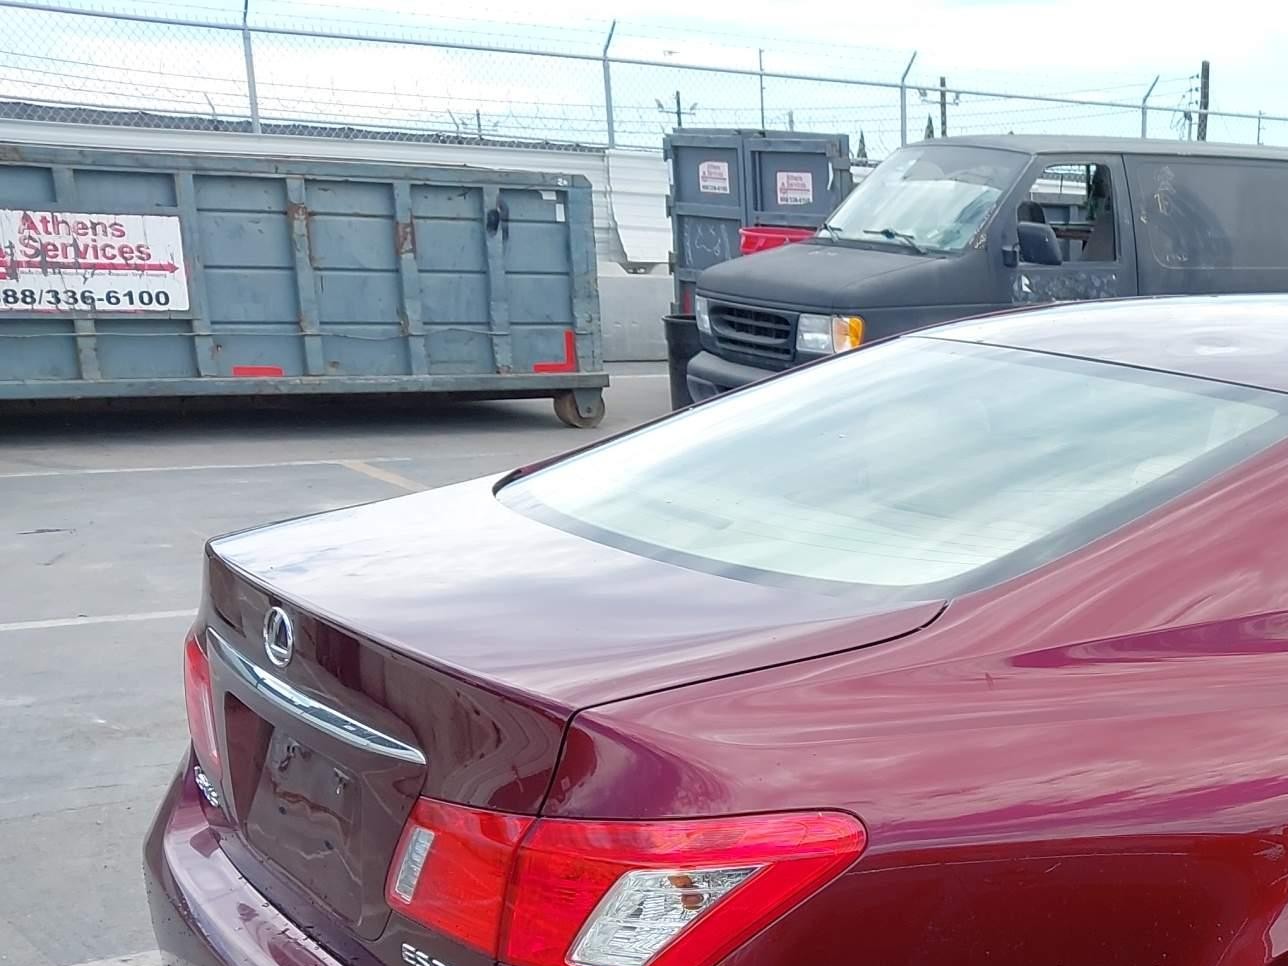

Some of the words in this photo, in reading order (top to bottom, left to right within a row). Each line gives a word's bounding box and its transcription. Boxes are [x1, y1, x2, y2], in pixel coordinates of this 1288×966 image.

[18, 211, 126, 237] Athens
[19, 235, 152, 261] Services
[0, 288, 170, 306] 88/336-6100
